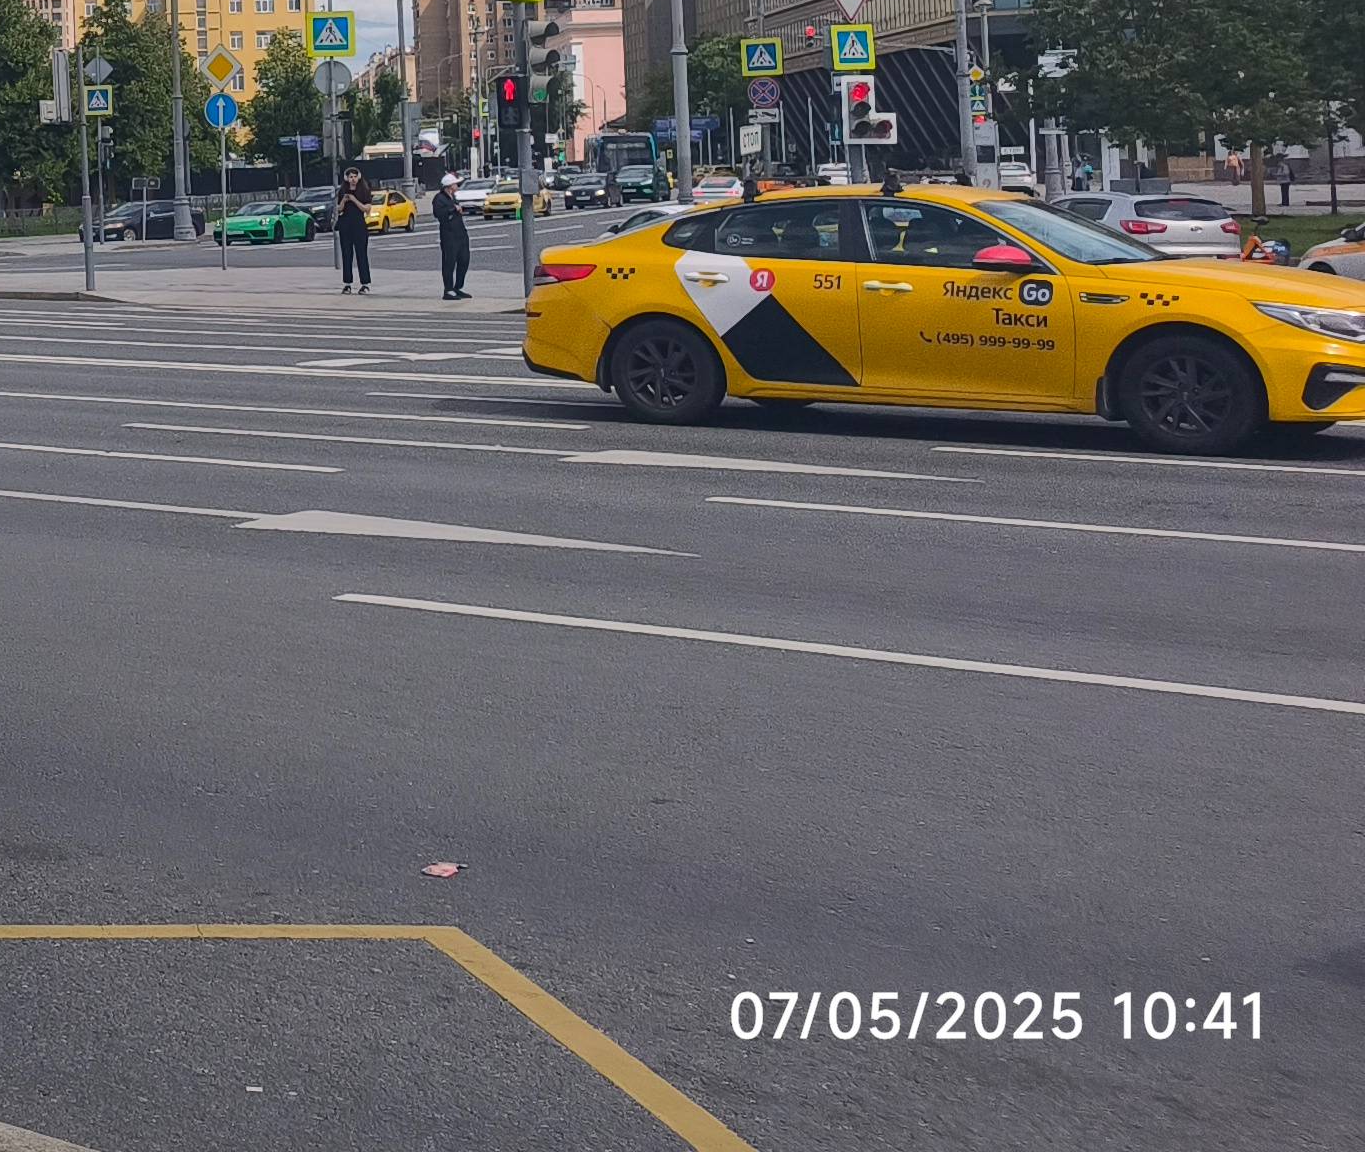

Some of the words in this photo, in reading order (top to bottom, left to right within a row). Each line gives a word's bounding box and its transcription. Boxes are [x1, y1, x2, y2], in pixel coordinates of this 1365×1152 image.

[742, 131, 759, 148] СТОП
[812, 273, 842, 290] 551
[942, 280, 1014, 301] Яндекс
[1023, 283, 1050, 302] Go
[991, 308, 1048, 328] Такси
[936, 331, 975, 347] (495)
[979, 335, 1056, 351] 999-99-99
